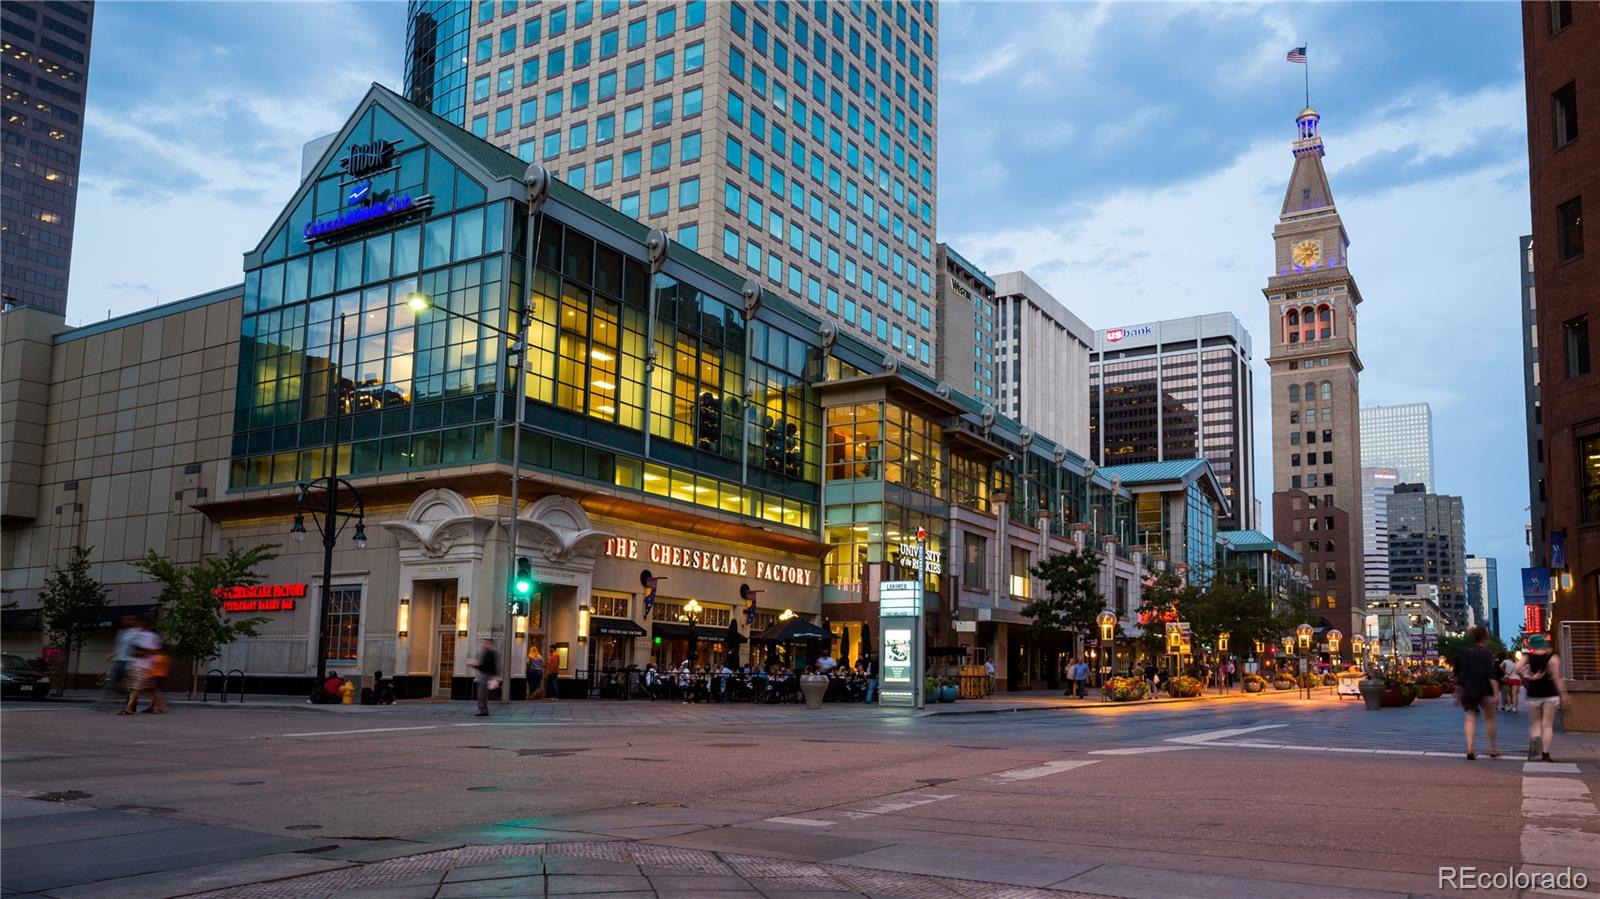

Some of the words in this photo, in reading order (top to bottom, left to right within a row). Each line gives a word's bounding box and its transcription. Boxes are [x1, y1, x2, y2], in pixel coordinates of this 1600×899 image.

[606, 537, 637, 559] THE
[651, 543, 747, 577] CHEESECAKE
[757, 561, 811, 586] FACTORY
[900, 543, 942, 563] UNIVSITY
[274, 584, 305, 598] FACTORY
